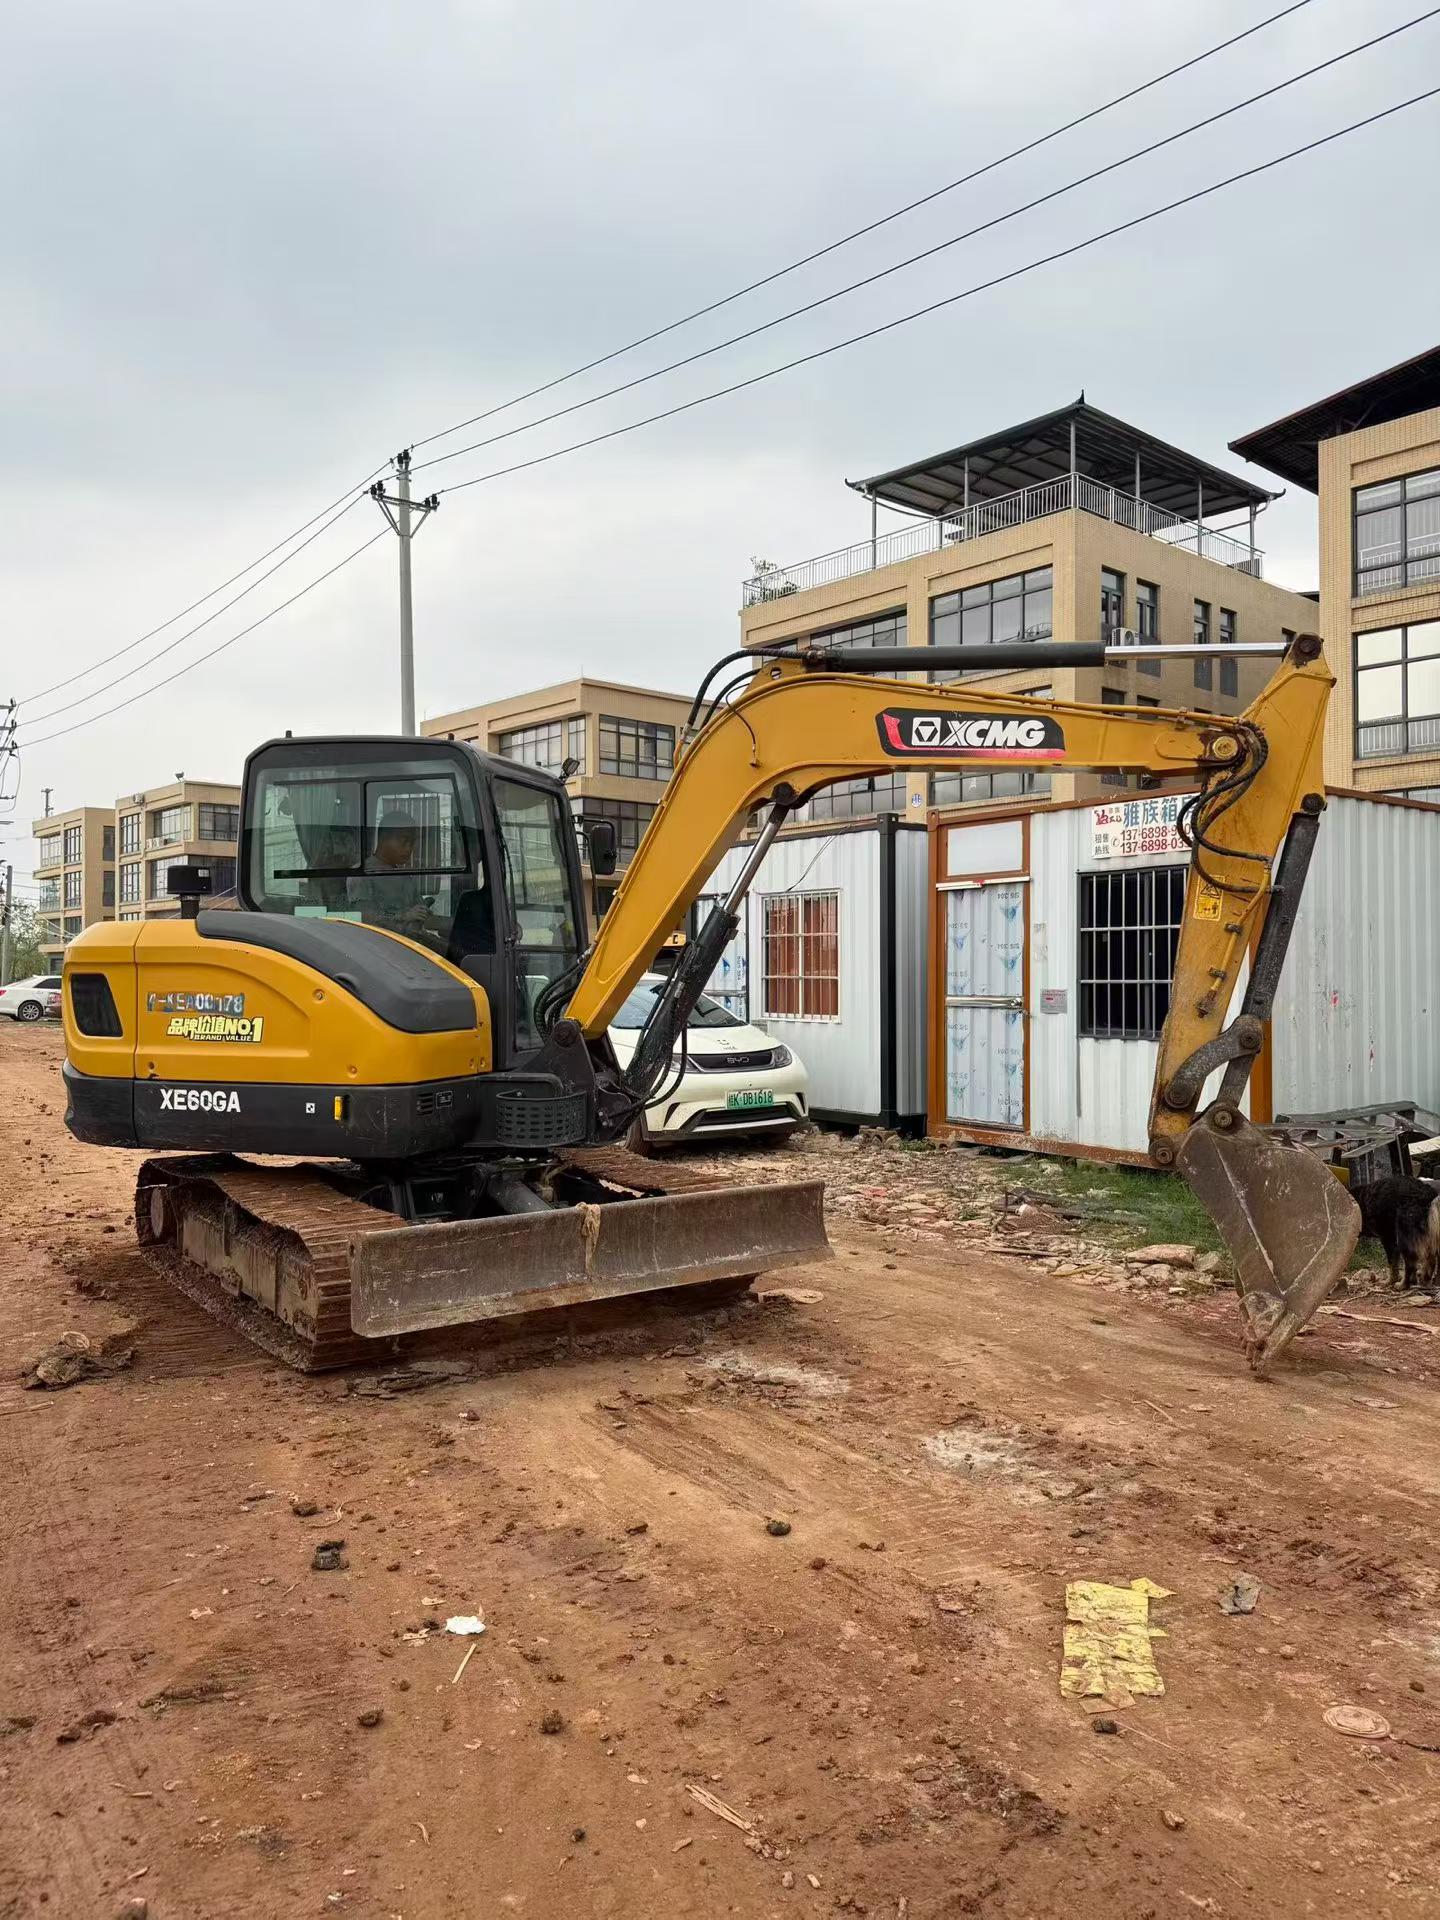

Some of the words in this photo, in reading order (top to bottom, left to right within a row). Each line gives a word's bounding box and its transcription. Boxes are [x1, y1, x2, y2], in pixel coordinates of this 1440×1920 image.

[940, 720, 1045, 747] XCMG
[727, 1056, 750, 1064] BYD
[160, 1088, 241, 1112] XE60GA
